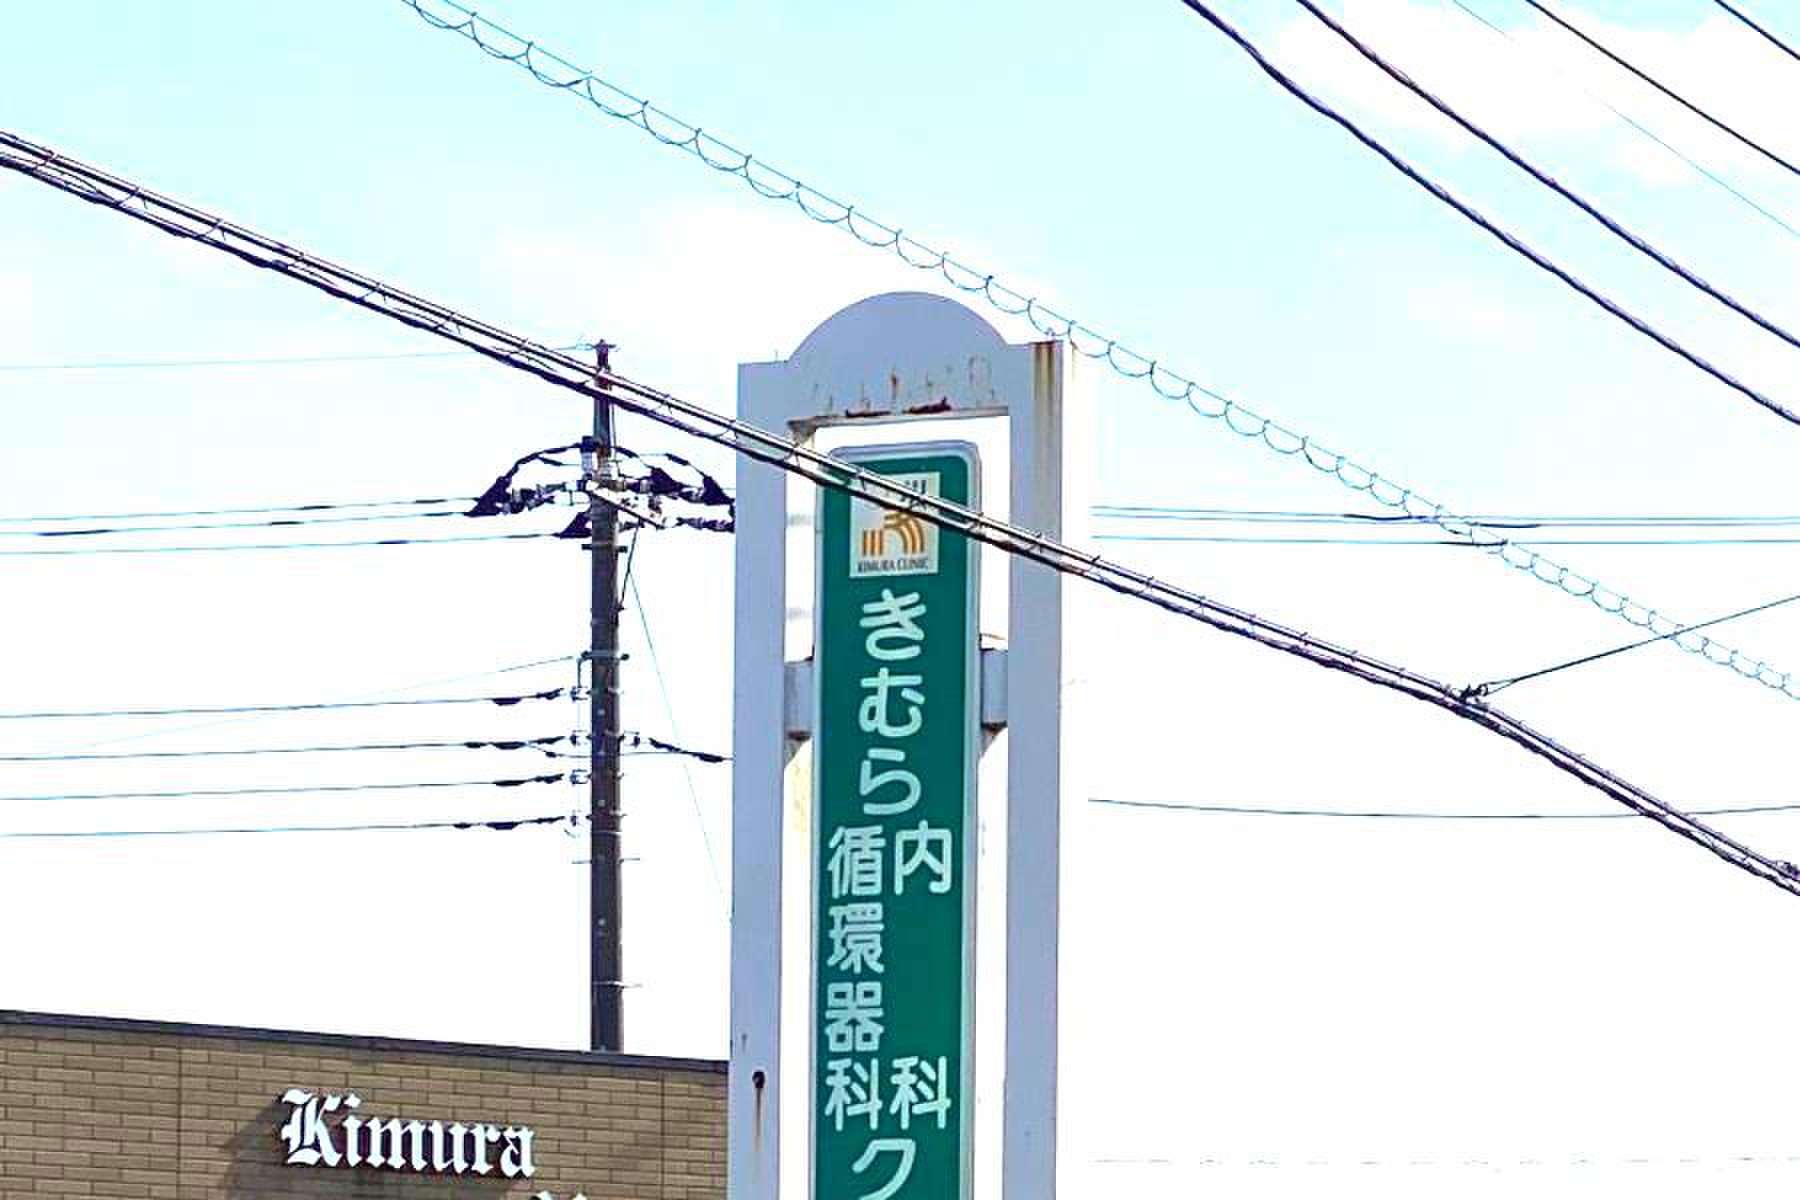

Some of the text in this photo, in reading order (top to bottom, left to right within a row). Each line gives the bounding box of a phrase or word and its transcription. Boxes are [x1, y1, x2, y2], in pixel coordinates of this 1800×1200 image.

[859, 588, 927, 815] きむら
[825, 825, 886, 1131] 循環器科
[281, 1088, 535, 1178] Kimura
